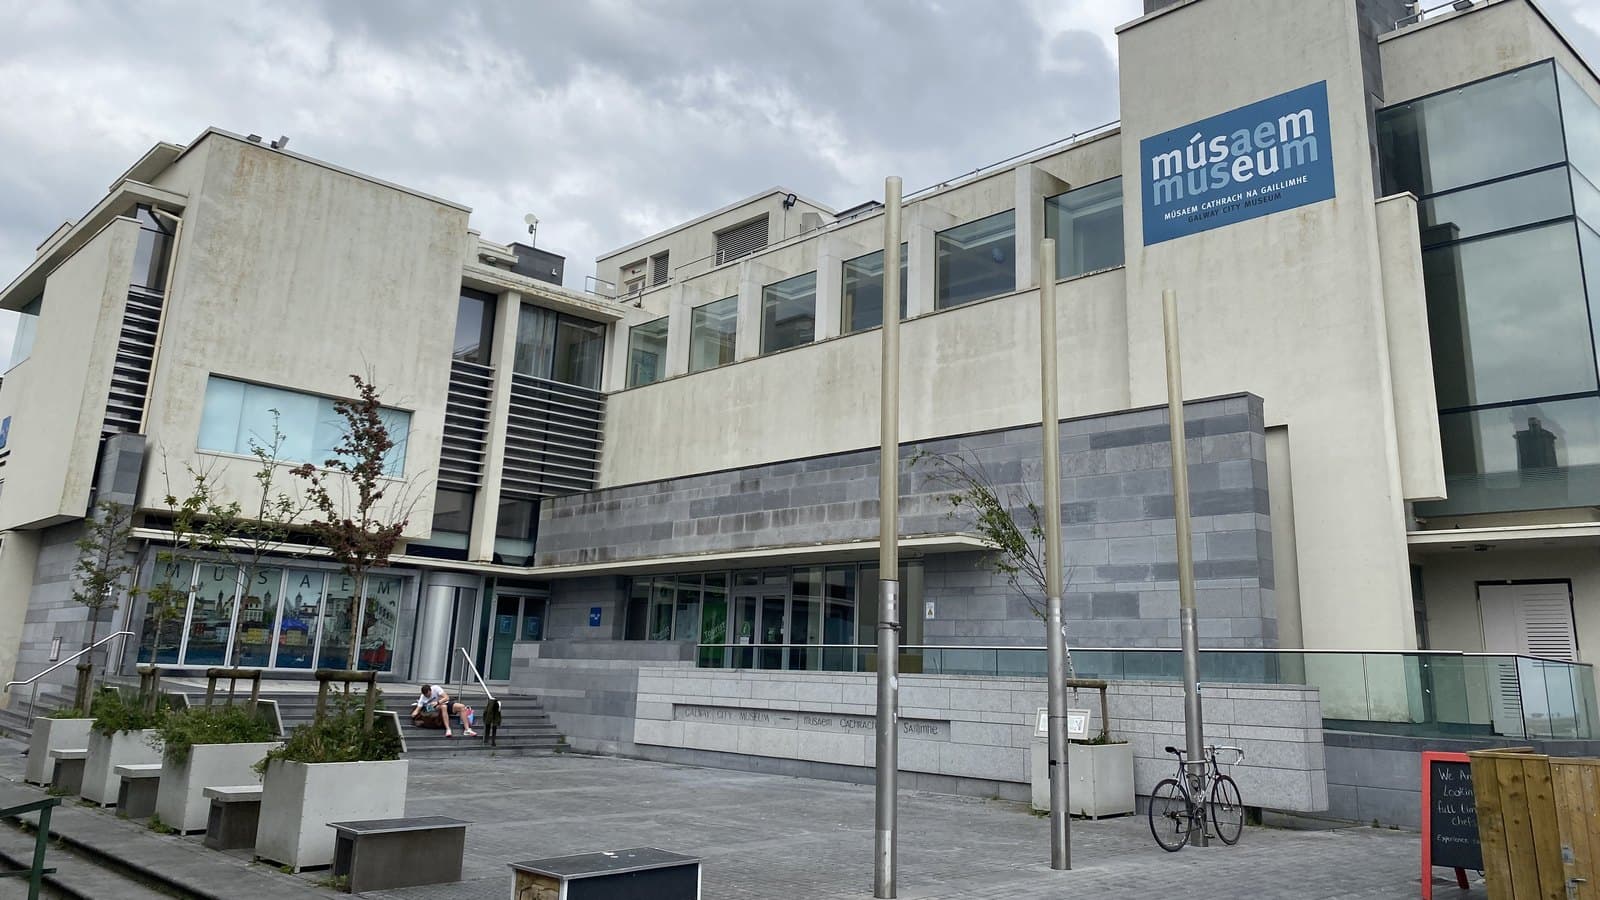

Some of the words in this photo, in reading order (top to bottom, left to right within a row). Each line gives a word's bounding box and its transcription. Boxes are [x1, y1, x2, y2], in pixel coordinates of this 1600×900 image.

[1152, 108, 1314, 180] músaem
[1153, 135, 1318, 206] museum
[1164, 205, 1198, 221] MÚSAEM
[1201, 193, 1243, 210] CATHRACH
[1246, 189, 1258, 198] NA
[1260, 175, 1309, 194] GAILLIMHE
[1188, 208, 1222, 223] GALWAY
[1222, 203, 1241, 214] CITY
[1244, 192, 1282, 208] MUSEUM
[716, 711, 733, 720] CITY
[740, 711, 770, 722] MUSEUM
[1438, 767, 1453, 781] We
